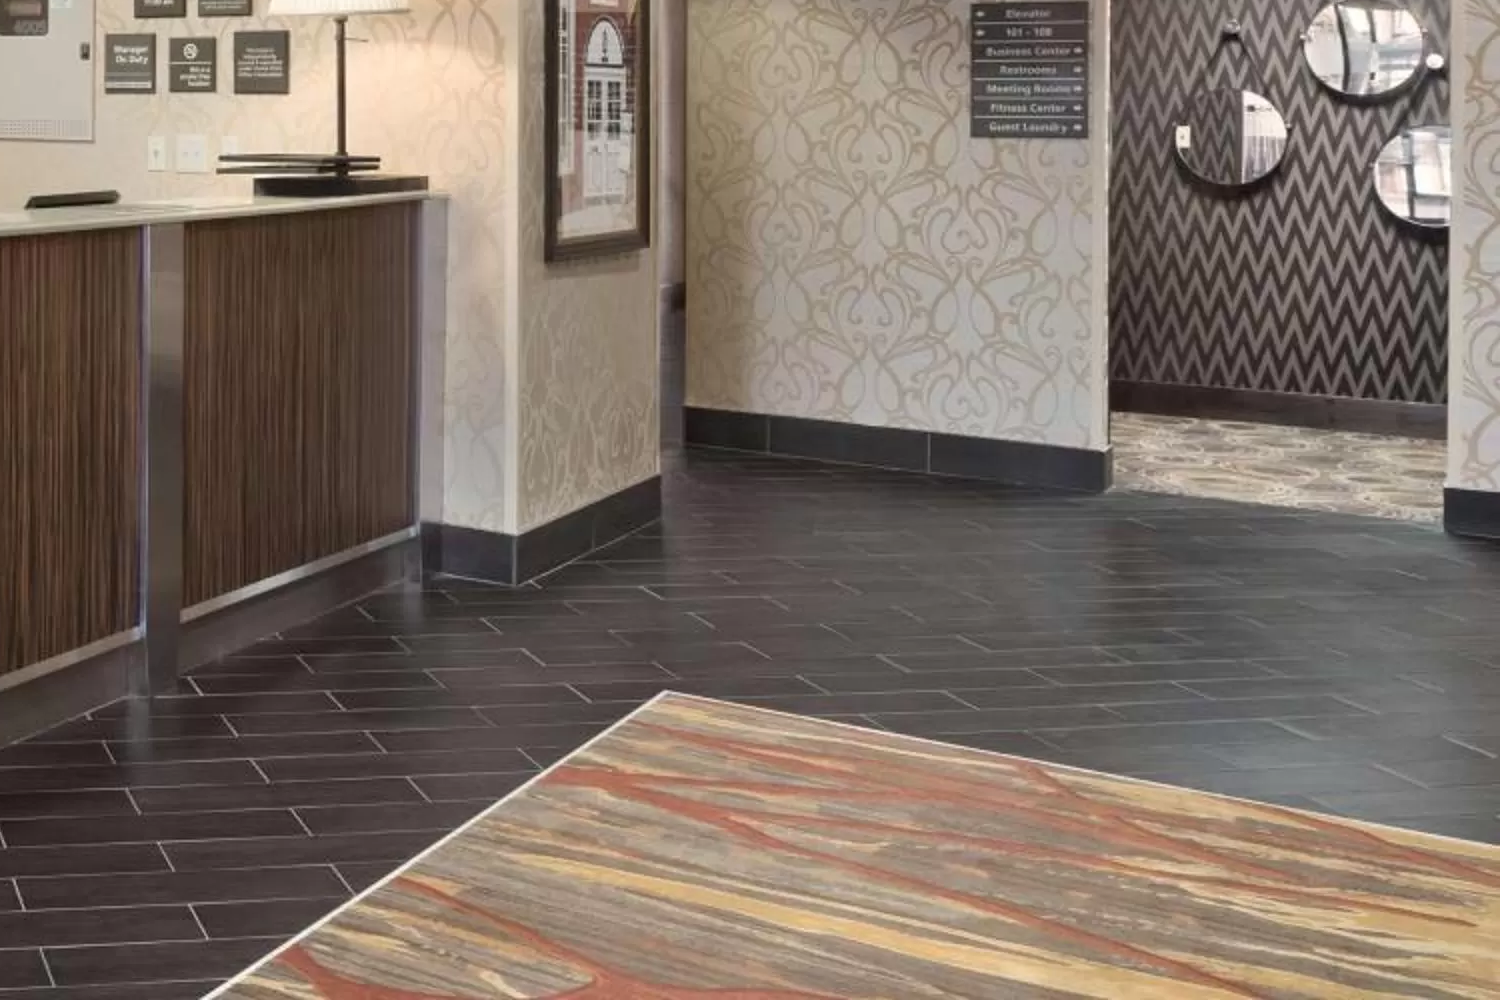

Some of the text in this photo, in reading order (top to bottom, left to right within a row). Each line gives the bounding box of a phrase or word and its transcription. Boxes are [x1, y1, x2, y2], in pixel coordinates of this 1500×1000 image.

[1004, 8, 1052, 19] Elevator
[985, 46, 1071, 57] Business Center
[1000, 65, 1057, 75] Restrooms
[985, 84, 1031, 96] Meeting
[990, 103, 1067, 113] Fitness Center
[989, 121, 1068, 135] Guest Laundry
